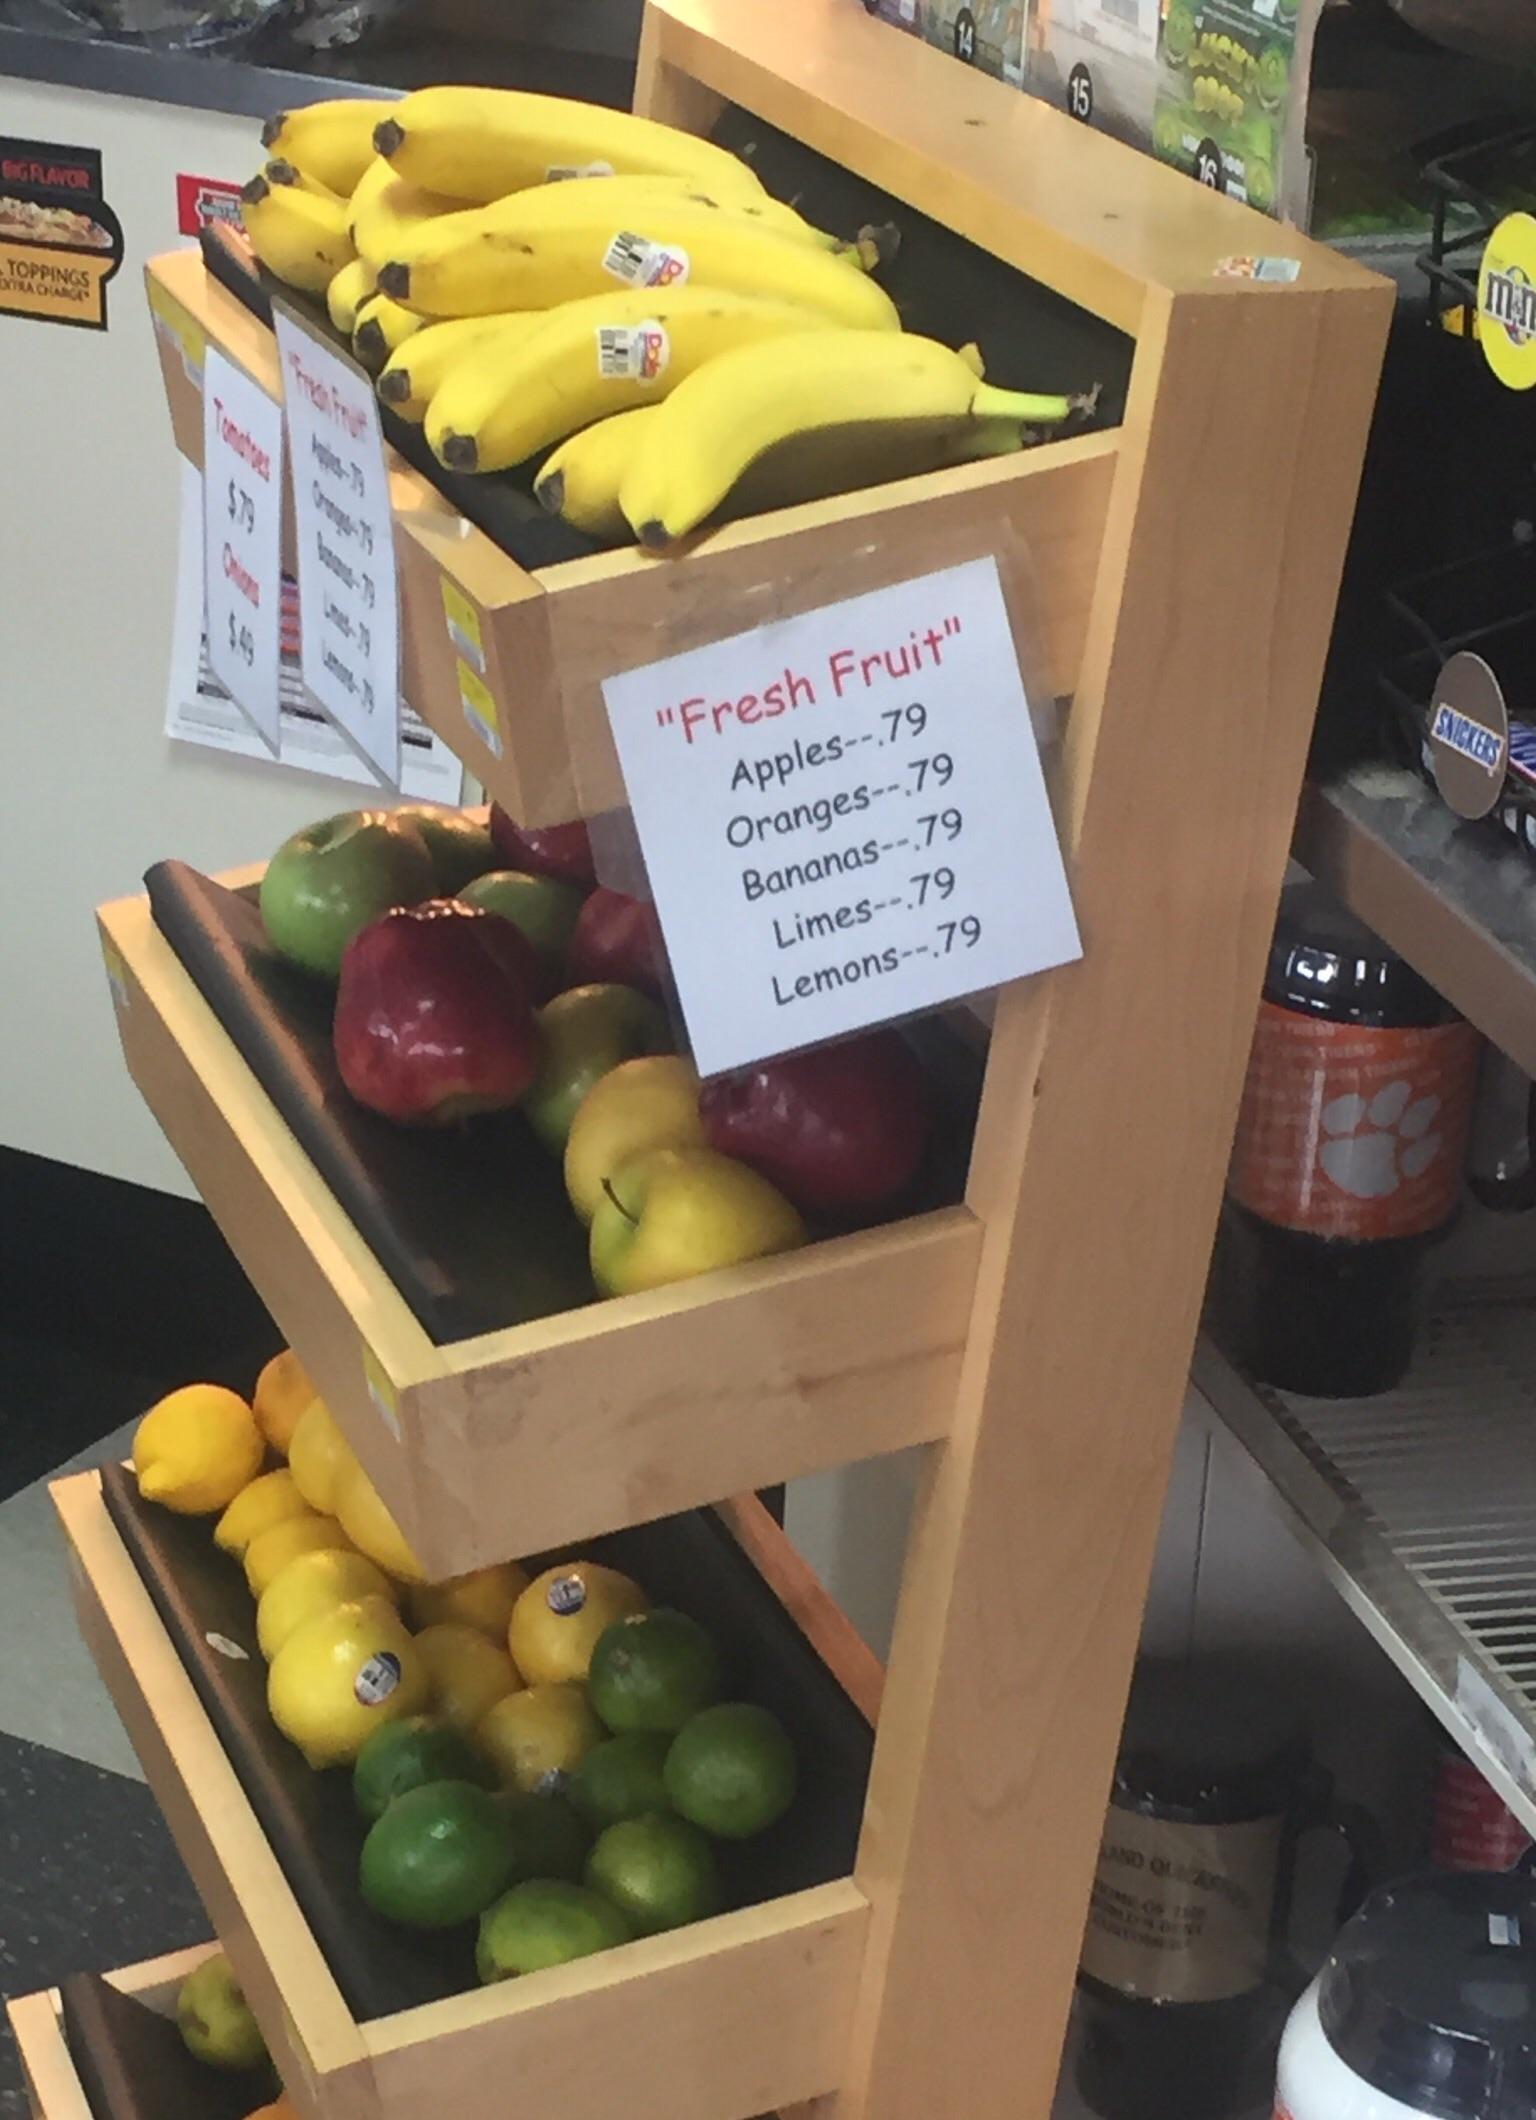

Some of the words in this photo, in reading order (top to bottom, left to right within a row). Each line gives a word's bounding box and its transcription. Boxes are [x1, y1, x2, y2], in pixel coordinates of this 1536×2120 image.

[958, 21, 974, 58] 14
[1071, 76, 1090, 117] 15
[7, 258, 90, 288] TOPPINGS
[655, 668, 816, 744] "Fresh
[828, 615, 962, 697] Fruit"
[1435, 706, 1502, 768] SNICKERS
